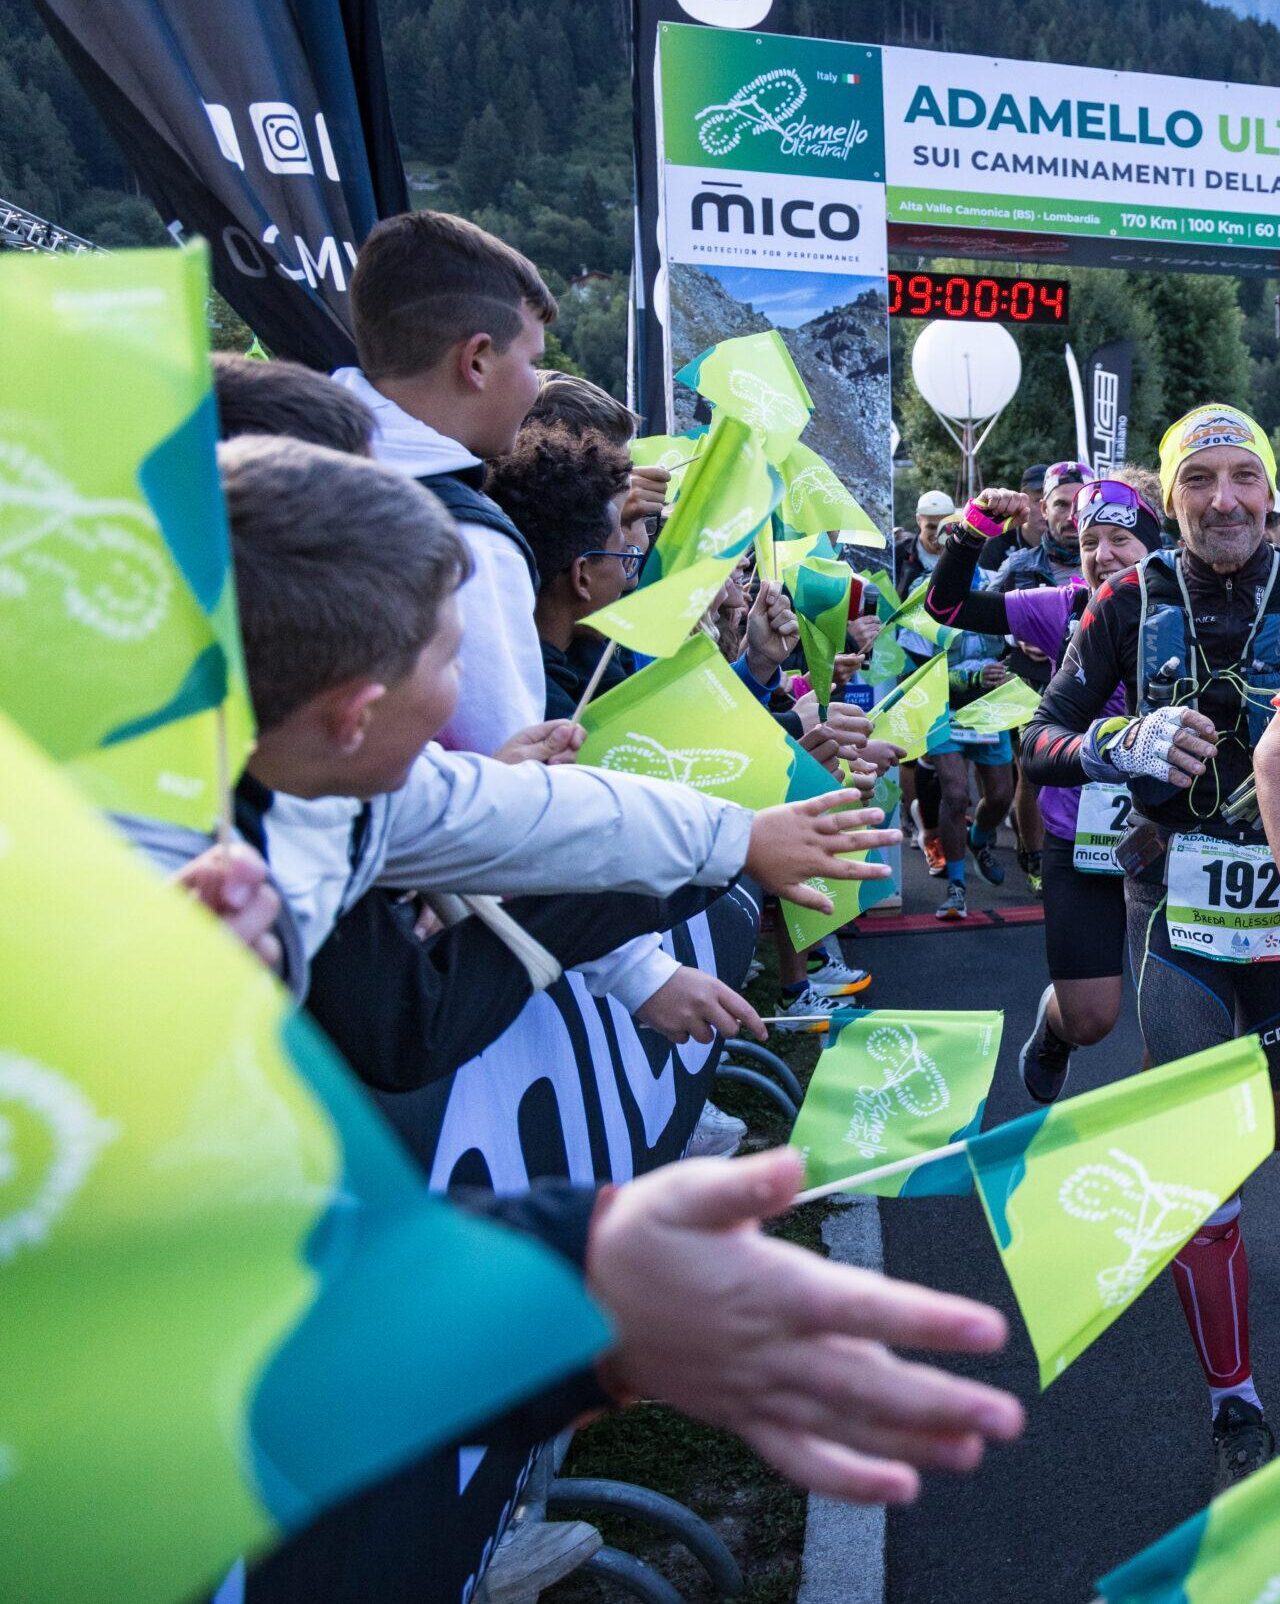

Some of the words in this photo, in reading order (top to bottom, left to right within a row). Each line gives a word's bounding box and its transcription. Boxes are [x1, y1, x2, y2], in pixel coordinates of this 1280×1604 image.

[816, 70, 838, 84] Italy
[904, 84, 1203, 148] ADAMELLO
[913, 145, 960, 169] SUI
[971, 151, 1195, 188] CAMMINAMENTI
[900, 201, 922, 212] Alta
[926, 203, 953, 214] Valle
[955, 205, 1010, 218] Camonica
[1013, 208, 1035, 222] (BS)
[1043, 211, 1100, 225] Lombardia
[1121, 213, 1147, 228] 170
[1150, 215, 1177, 231] Km
[1189, 217, 1215, 233] 100
[1218, 220, 1244, 236] Km
[1255, 222, 1275, 237] 60
[693, 244, 757, 257] PROTECTION
[763, 248, 782, 258] FOR
[787, 250, 860, 263] PERFORMANCE
[1192, 909, 1226, 926] BREDA
[1234, 914, 1280, 928] ALESSIO
